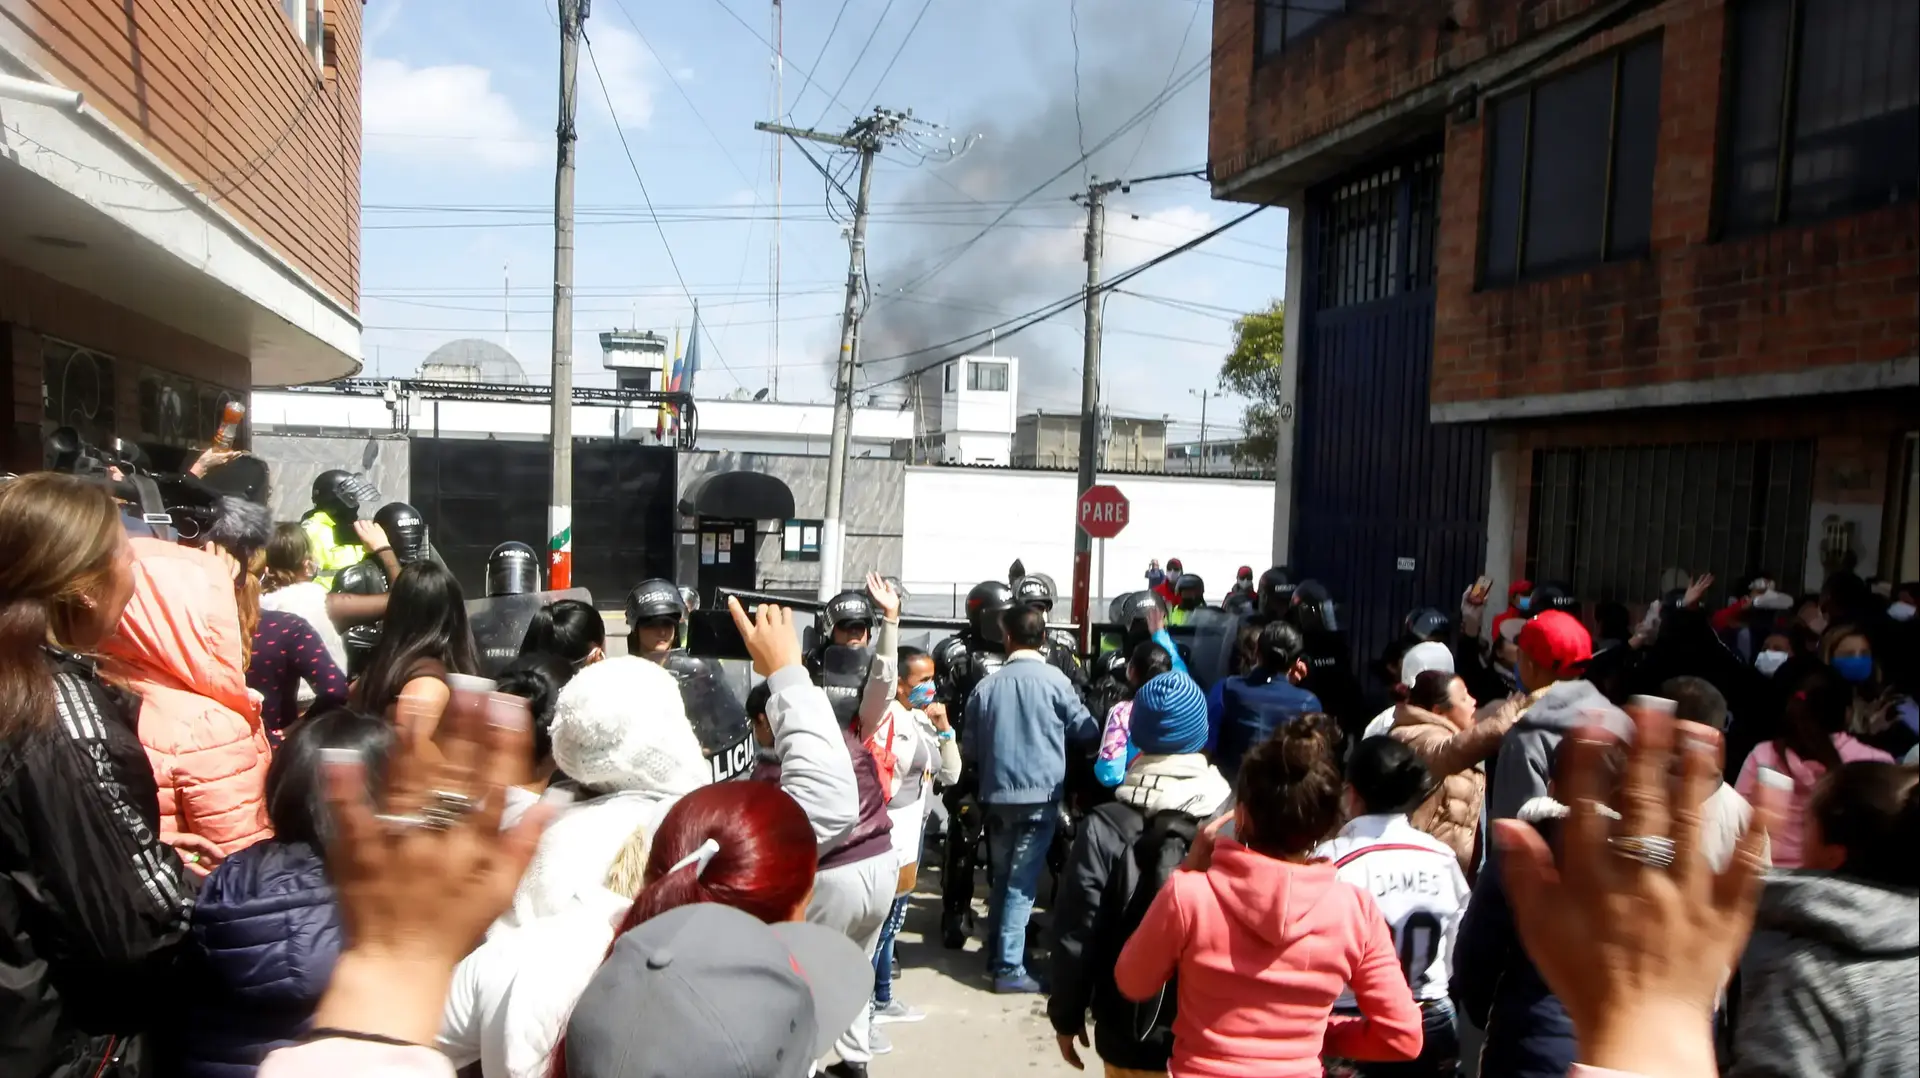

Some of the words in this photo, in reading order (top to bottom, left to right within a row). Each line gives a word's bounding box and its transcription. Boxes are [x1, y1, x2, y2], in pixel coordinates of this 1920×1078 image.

[1082, 501, 1124, 522] PARE
[713, 732, 754, 783] LICIA
[1376, 870, 1439, 897] JAMES
[1389, 910, 1441, 985] 0
